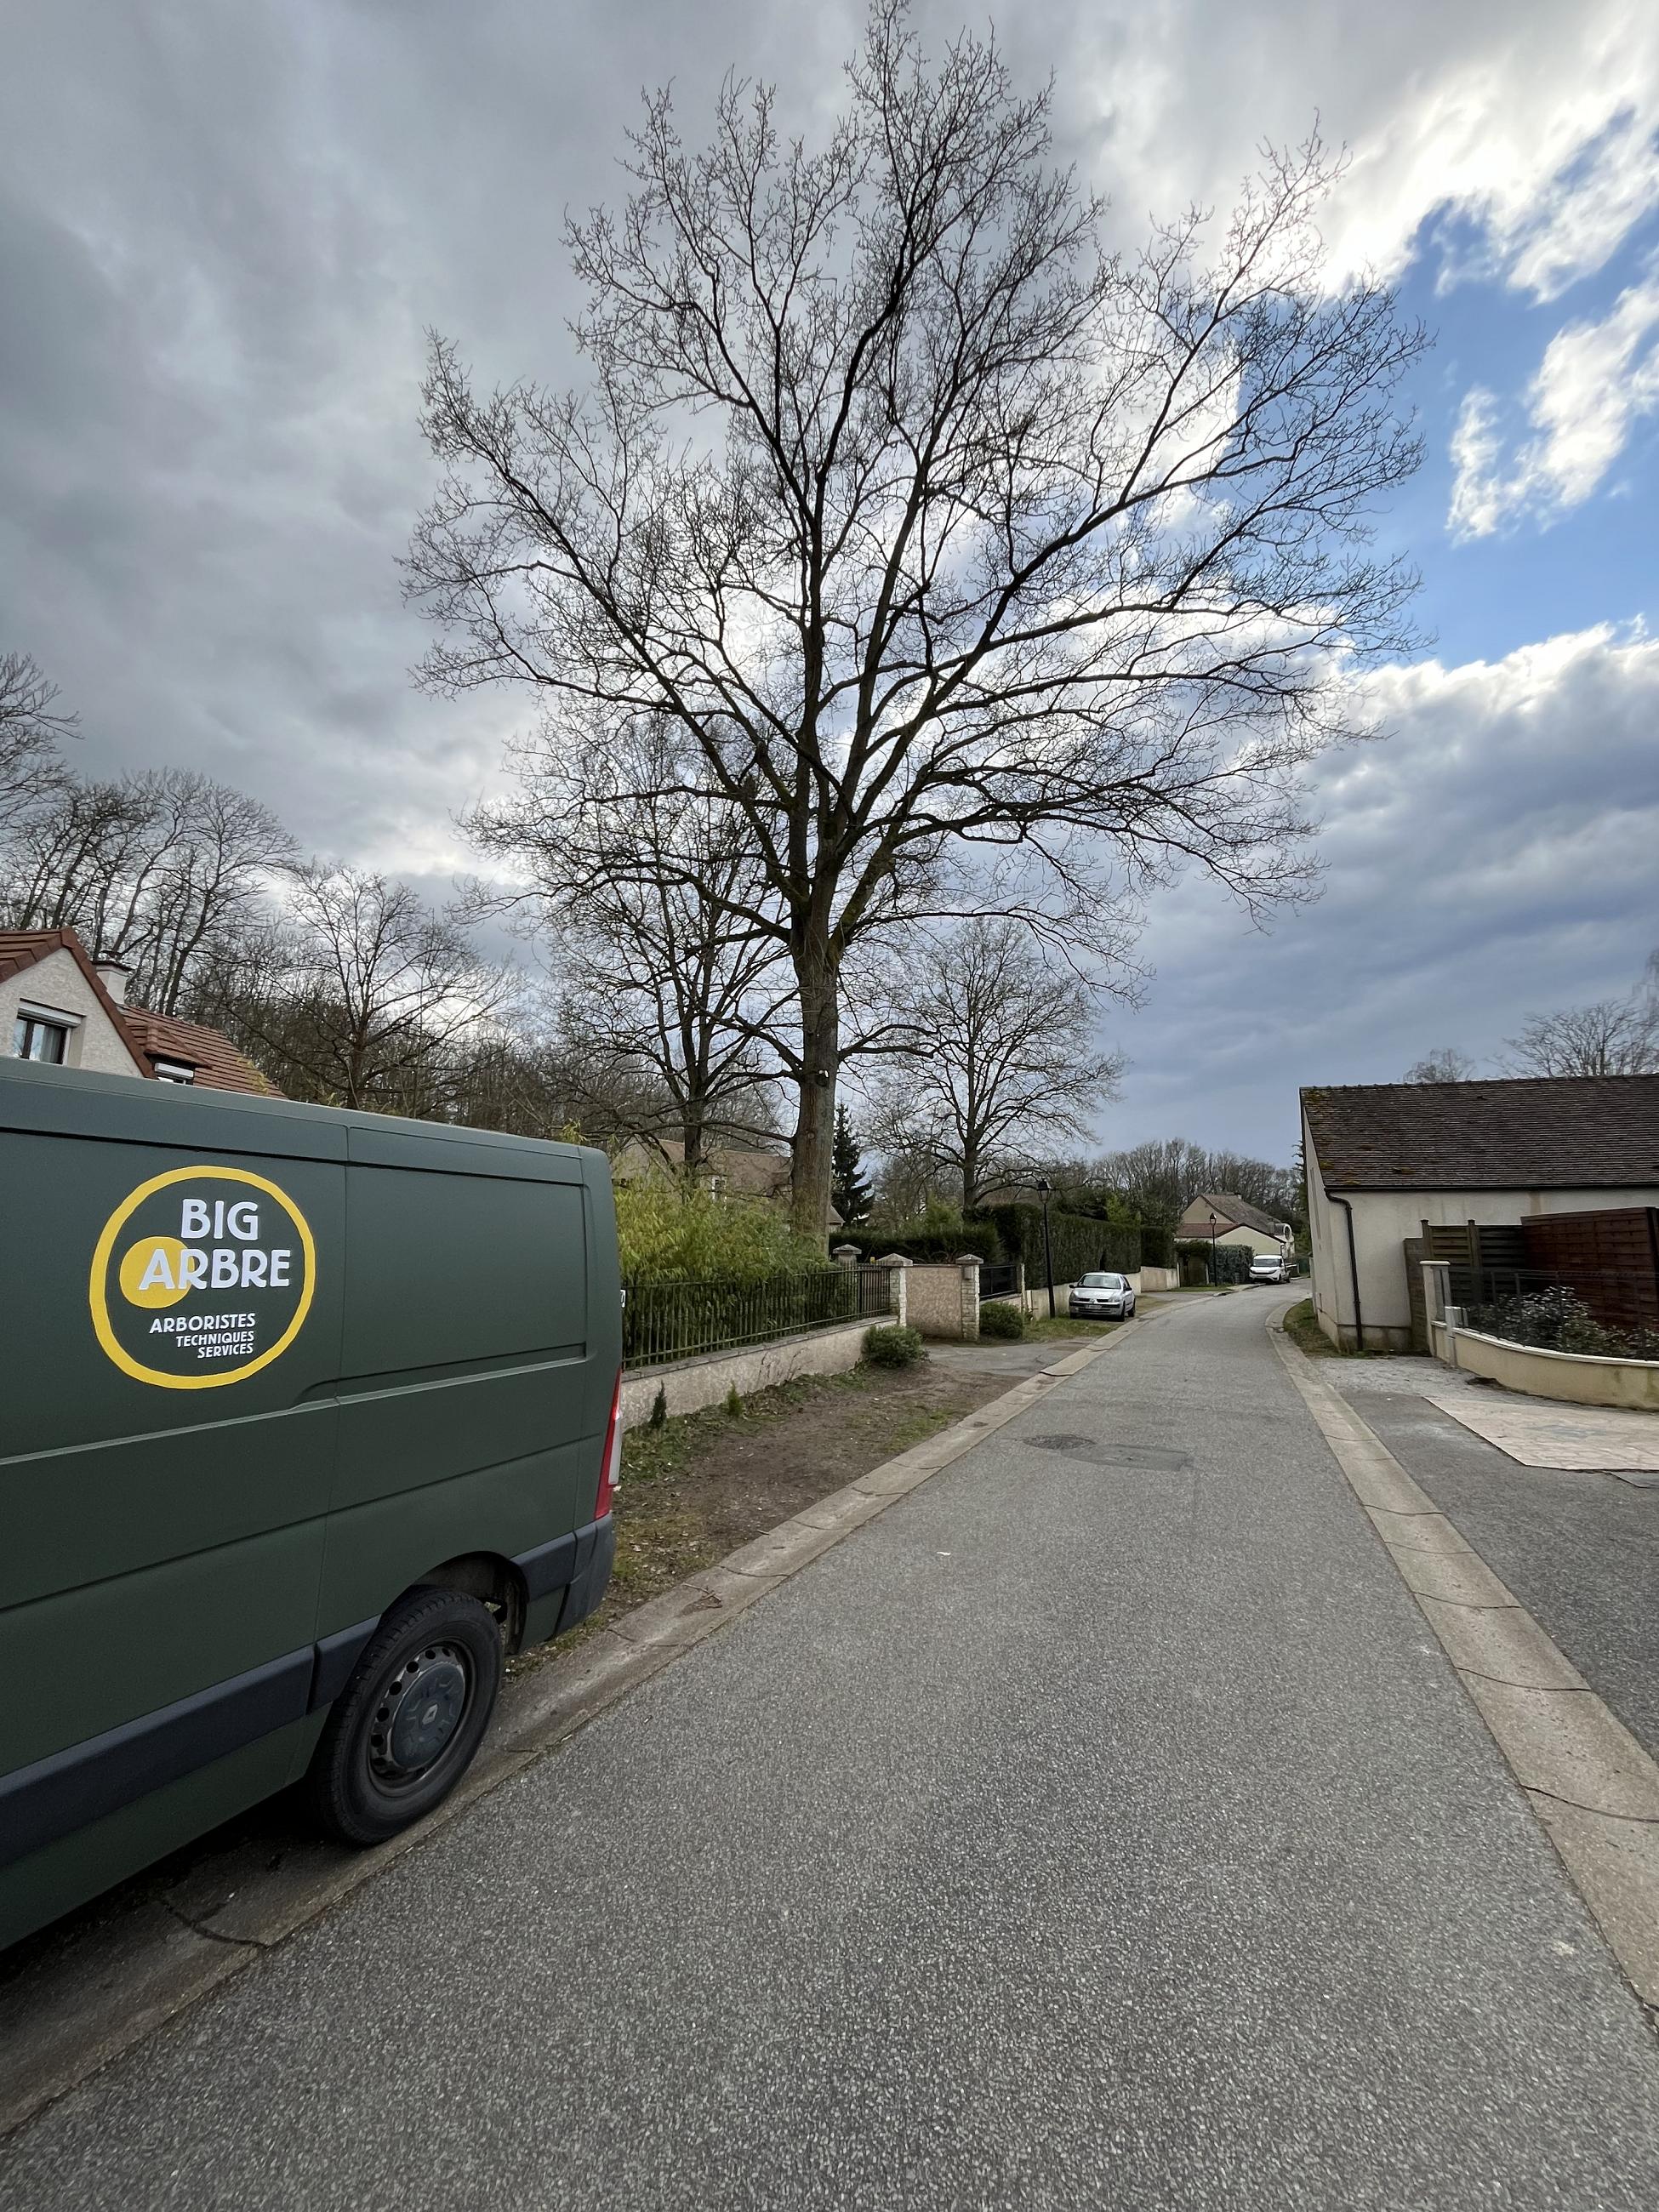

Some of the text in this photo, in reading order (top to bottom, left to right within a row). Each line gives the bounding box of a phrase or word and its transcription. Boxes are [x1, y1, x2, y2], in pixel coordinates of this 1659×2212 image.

[180, 1198, 259, 1240] BIG
[139, 1248, 291, 1291] ARBRE
[149, 1313, 255, 1334] ARBORISTES
[176, 1331, 254, 1348] TECHNIQUES
[197, 1343, 254, 1359] SERVICES
